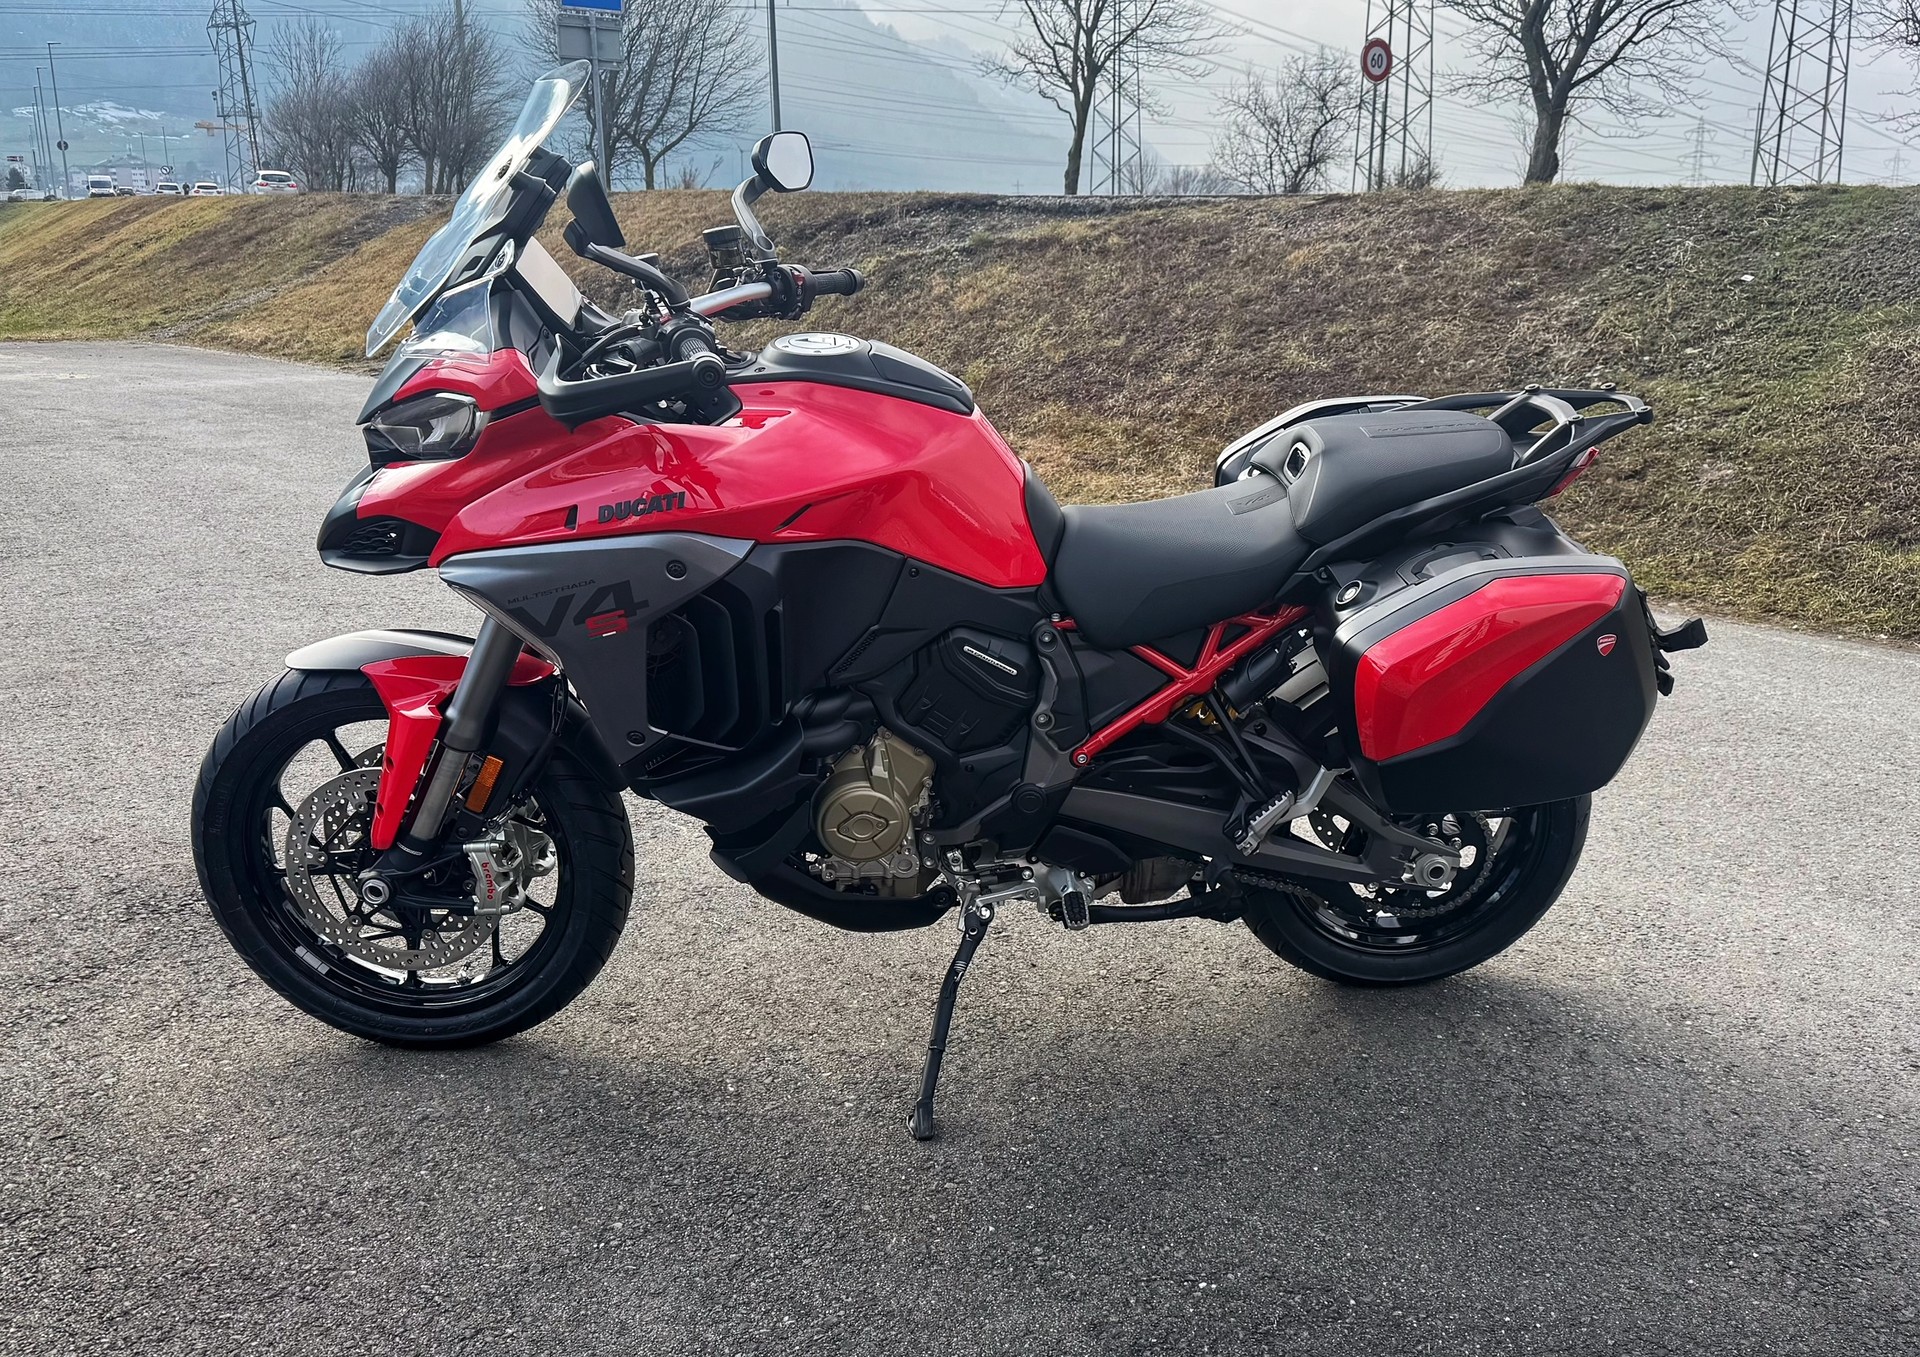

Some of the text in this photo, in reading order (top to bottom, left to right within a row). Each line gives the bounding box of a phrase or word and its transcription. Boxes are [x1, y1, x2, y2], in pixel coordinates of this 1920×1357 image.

[1370, 53, 1383, 69] 60
[598, 491, 685, 524] DUCATI
[507, 579, 596, 605] MULTISTRADA
[505, 580, 650, 638] V4
[481, 861, 496, 900] brembo
